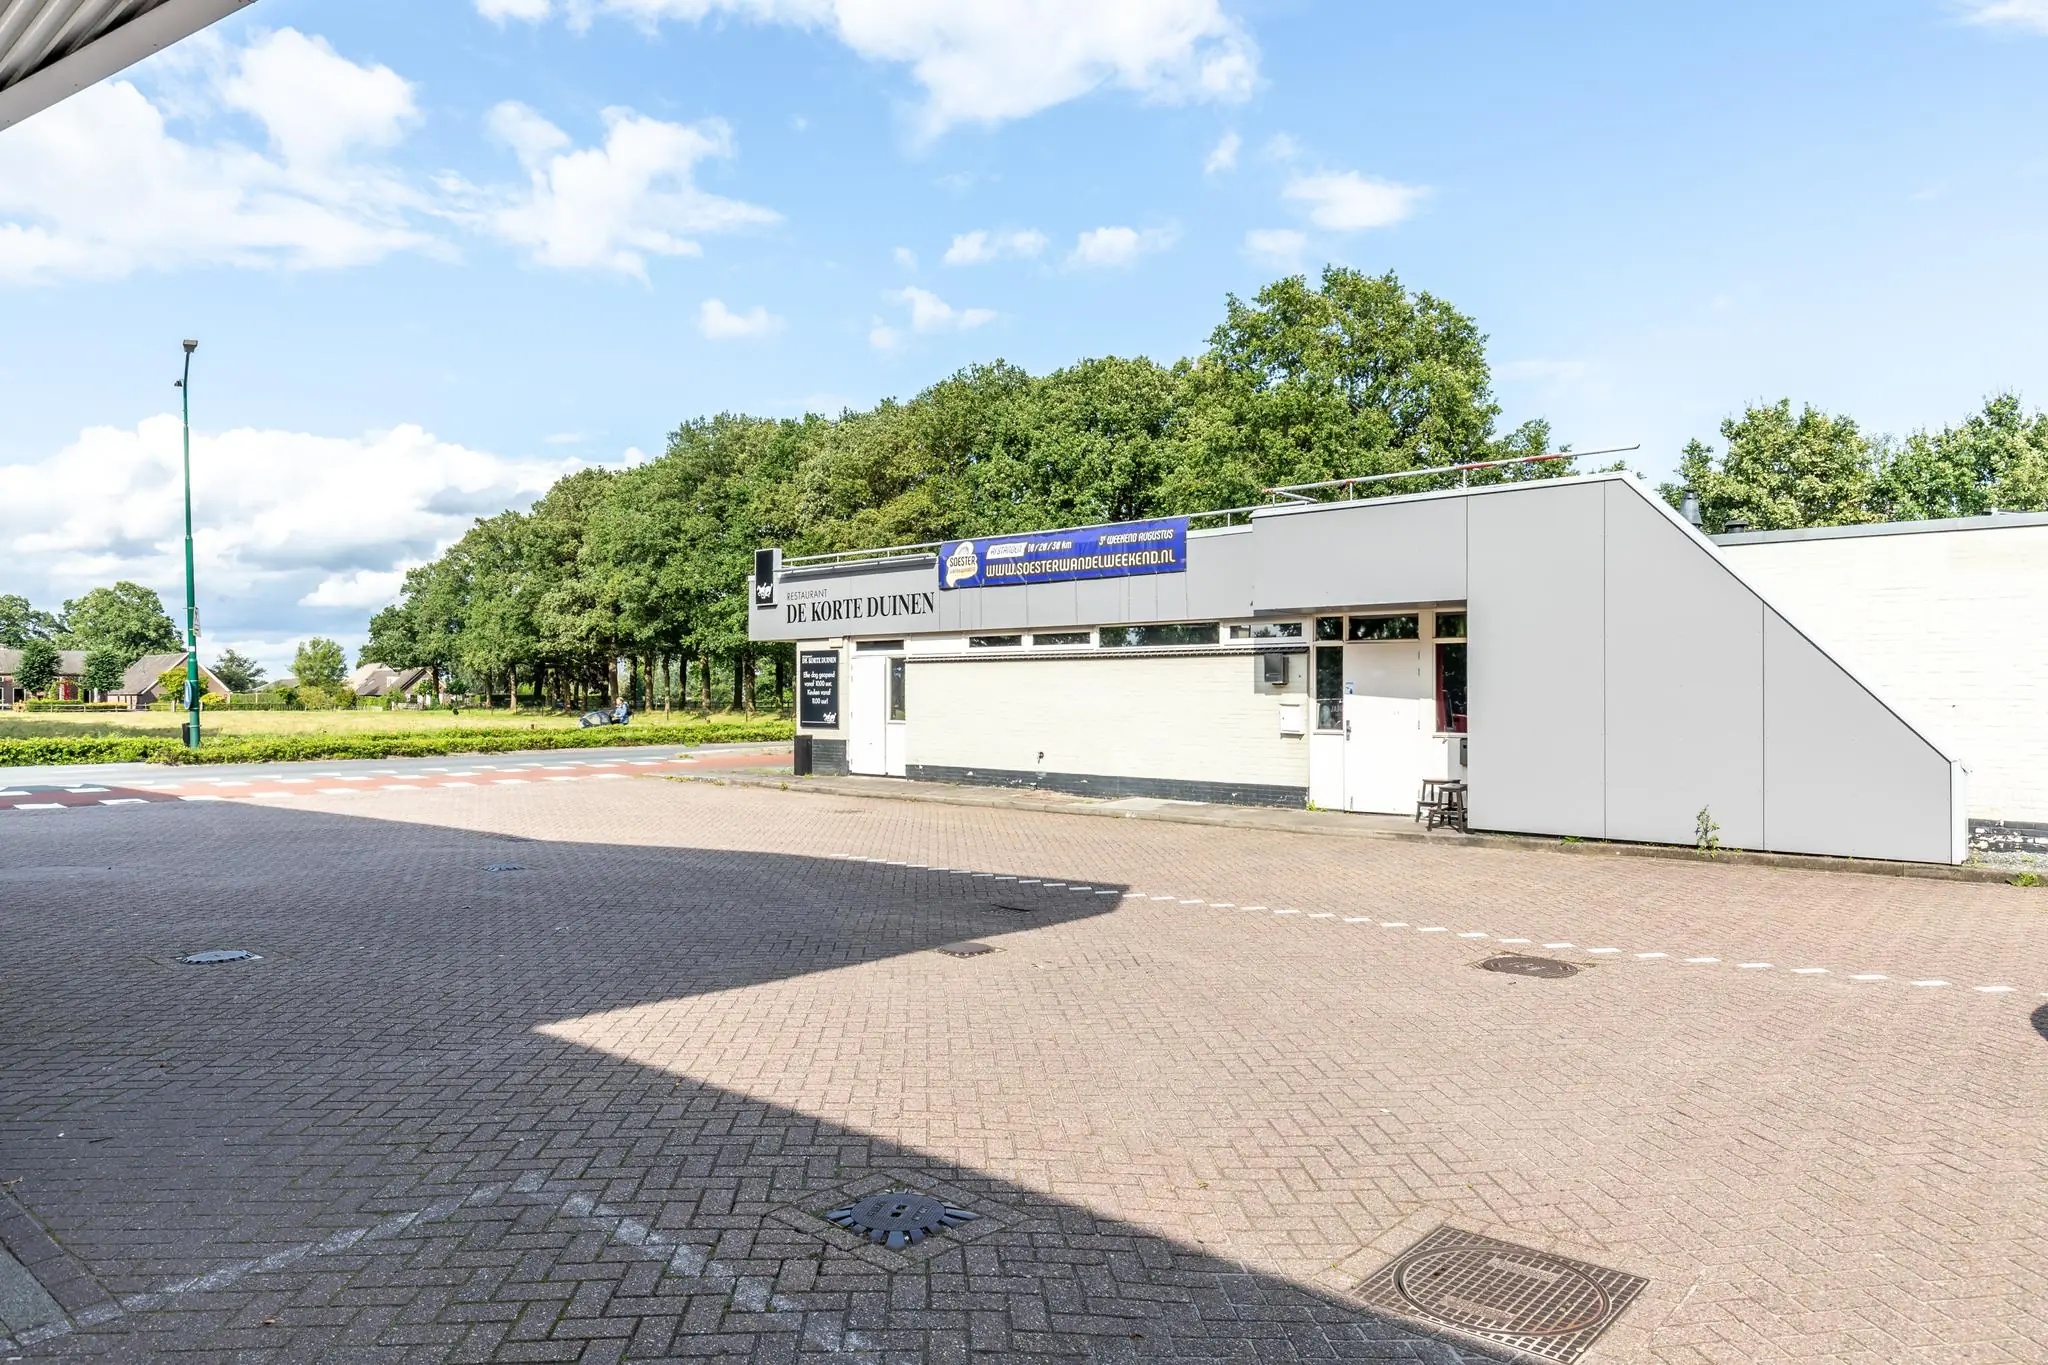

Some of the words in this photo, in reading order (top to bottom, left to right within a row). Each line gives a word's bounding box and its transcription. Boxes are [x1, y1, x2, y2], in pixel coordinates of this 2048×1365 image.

[1107, 533, 1138, 545] WEEKEND
[1138, 529, 1174, 542] AUGUSTUS
[950, 555, 976, 567] SOESTER
[986, 549, 1176, 577] WWW.SOESTERWANDELWEEKEND.NL
[786, 589, 829, 601] RESTAURANT
[786, 603, 807, 624] DE
[811, 597, 863, 622] KORTE
[867, 592, 935, 618] DUINEN
